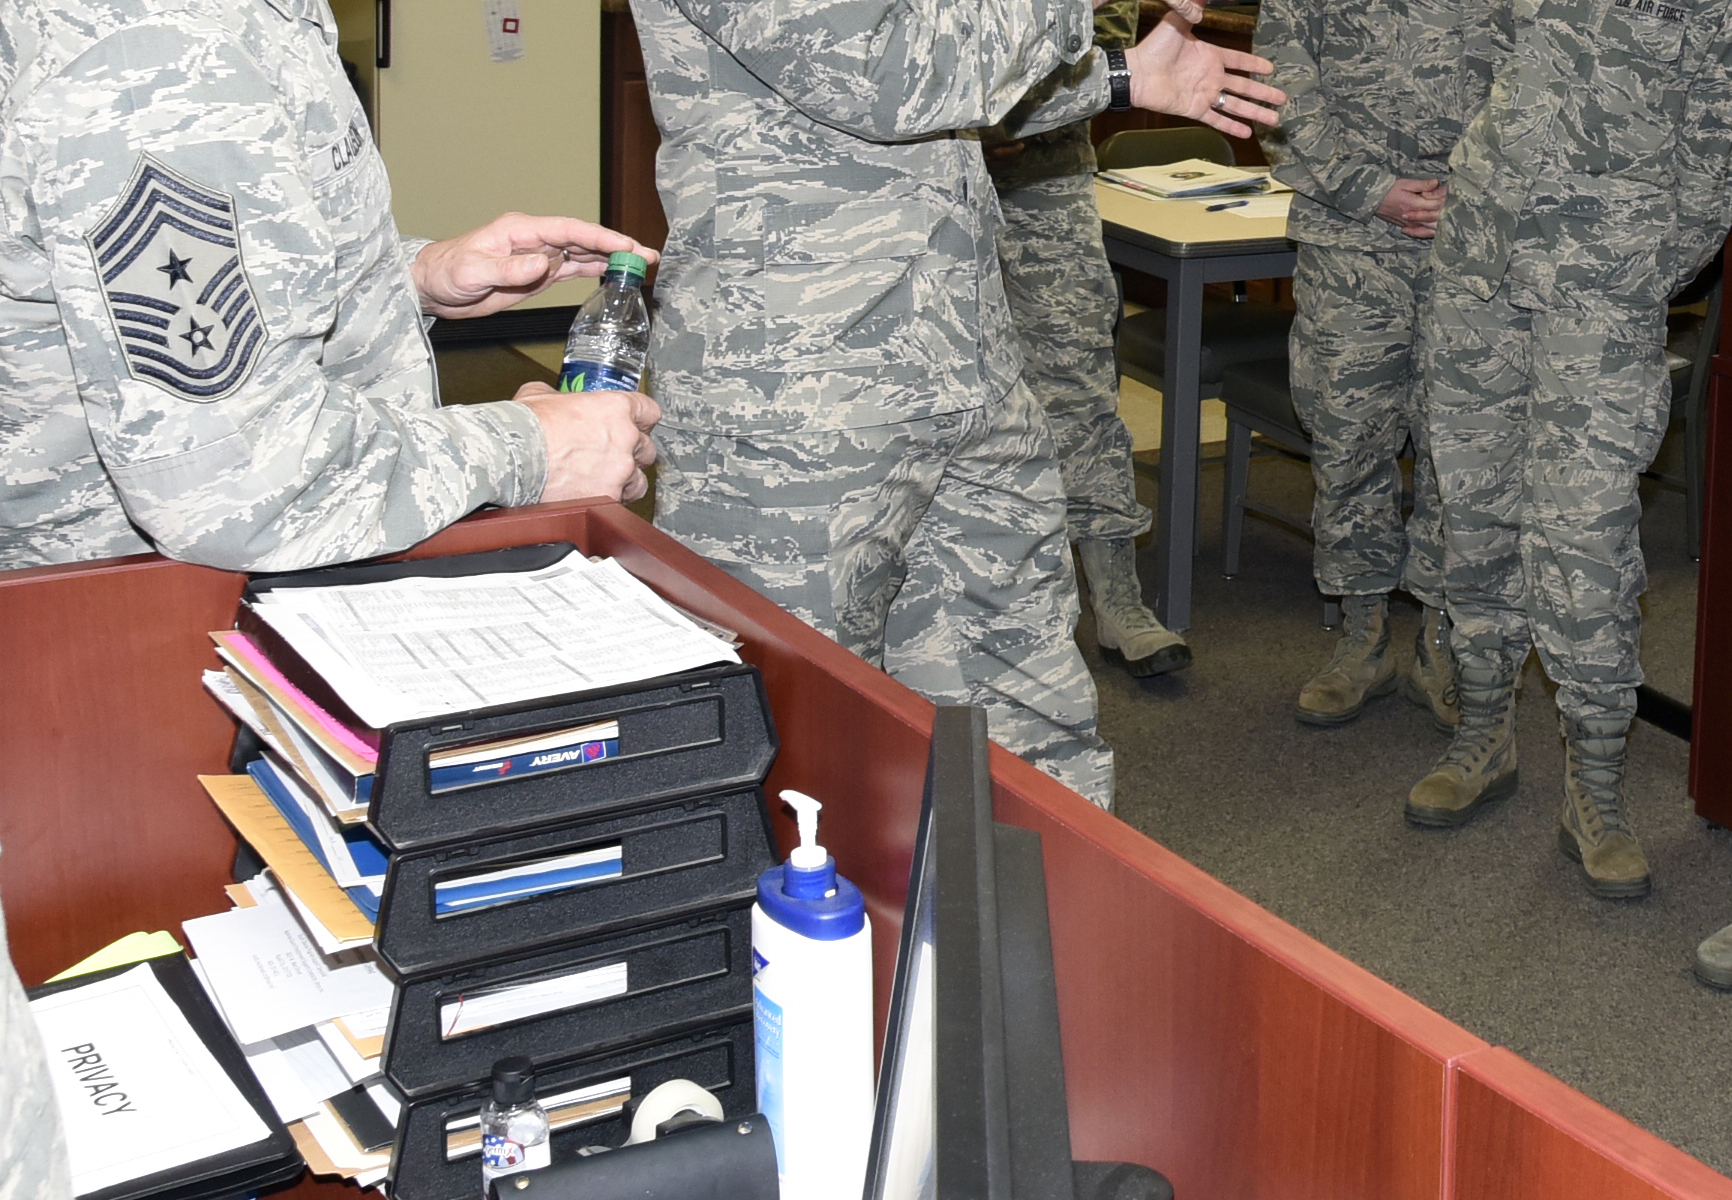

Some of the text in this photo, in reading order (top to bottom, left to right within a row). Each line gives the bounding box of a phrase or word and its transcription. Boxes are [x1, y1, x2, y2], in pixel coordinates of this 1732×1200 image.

[1656, 3, 1686, 24] FORCE
[529, 749, 581, 767] AVERY
[60, 1042, 138, 1116] PRIVACY
